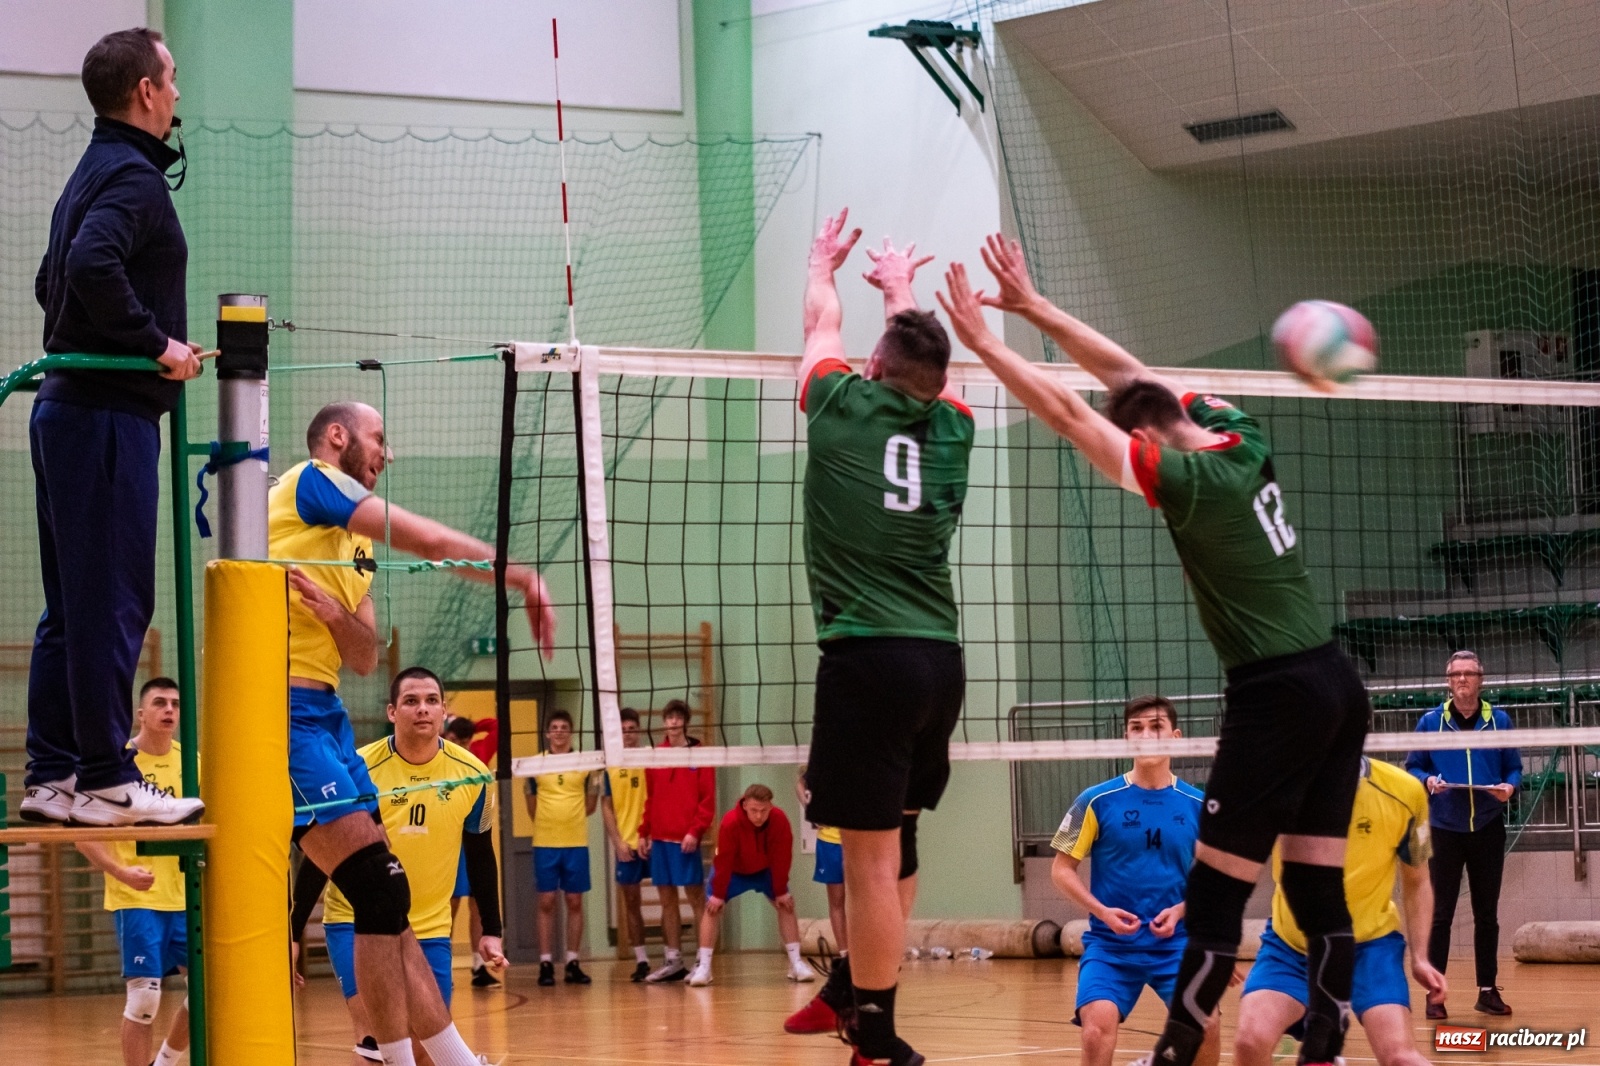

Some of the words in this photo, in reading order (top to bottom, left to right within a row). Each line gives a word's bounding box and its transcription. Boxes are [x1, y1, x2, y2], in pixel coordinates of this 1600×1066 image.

[883, 434, 922, 512] 9
[1253, 482, 1296, 557] 12
[557, 774, 564, 786] 5
[408, 803, 426, 827] 10
[1144, 827, 1163, 850] 14
